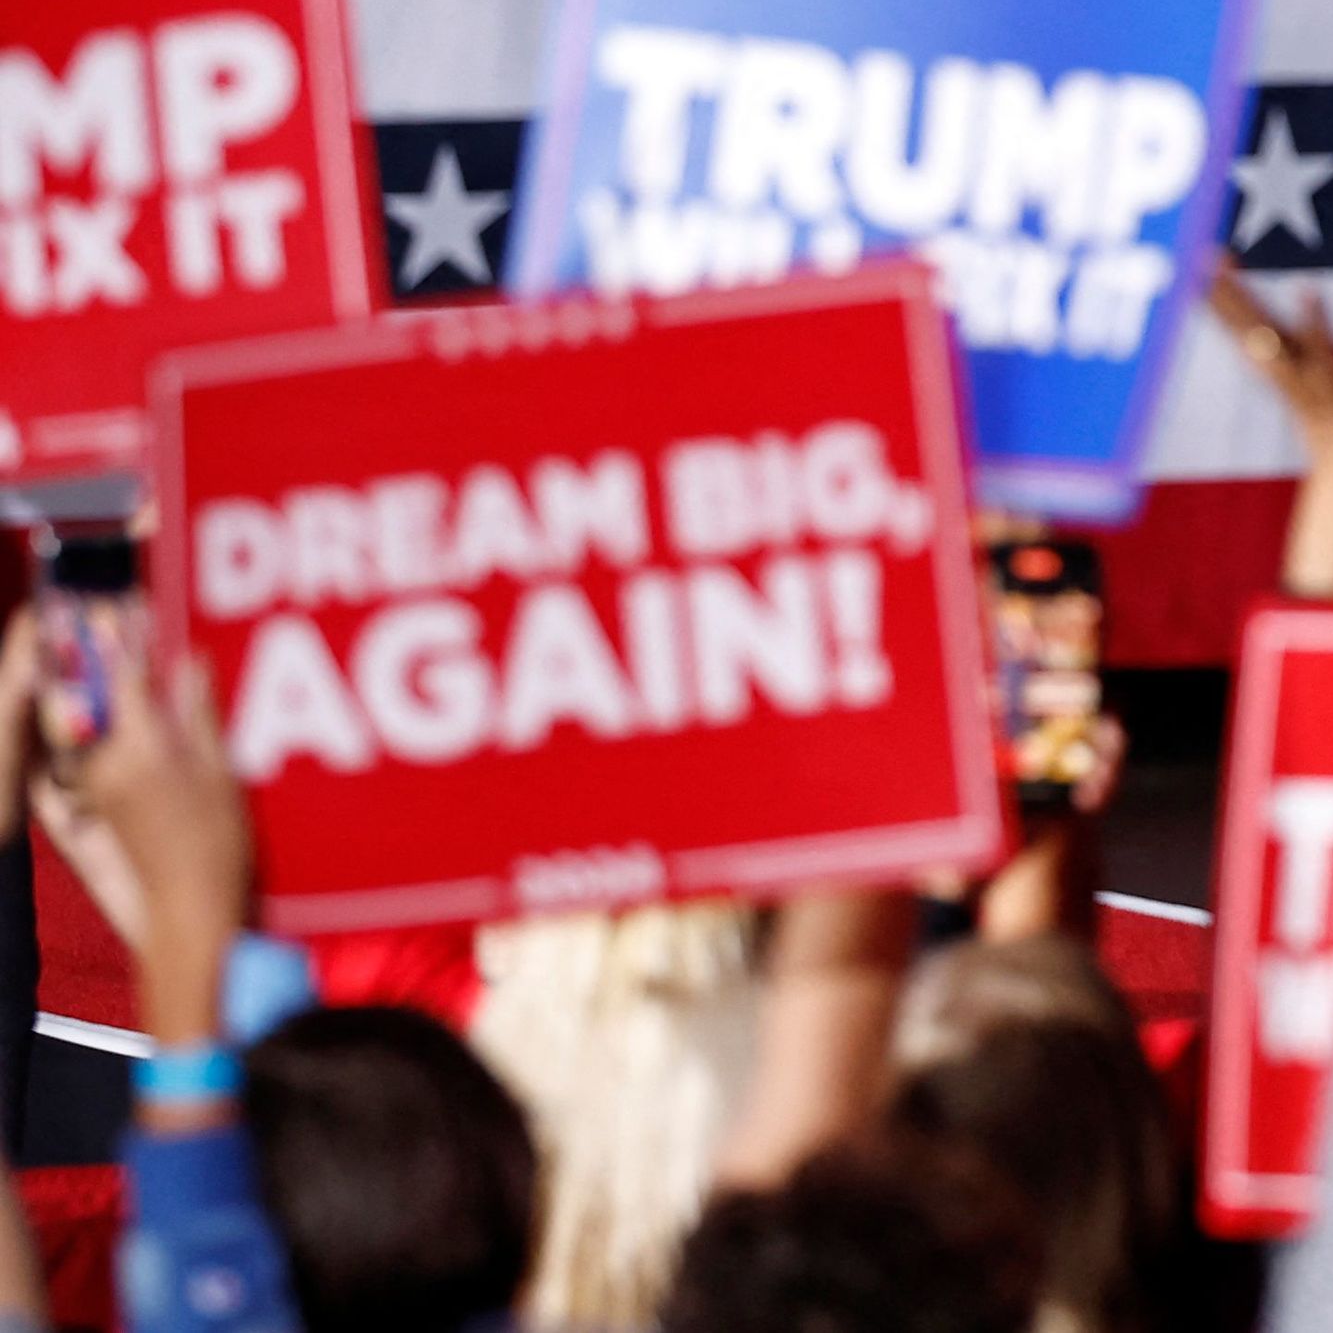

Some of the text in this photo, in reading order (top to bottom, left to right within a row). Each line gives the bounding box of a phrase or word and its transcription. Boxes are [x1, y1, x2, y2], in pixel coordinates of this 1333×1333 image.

[164, 170, 306, 299] IT
[598, 22, 1207, 246] TRUMP
[1068, 244, 1177, 361] IT
[194, 418, 935, 621] DREAM BIG,
[230, 548, 896, 782] AGAIN!
